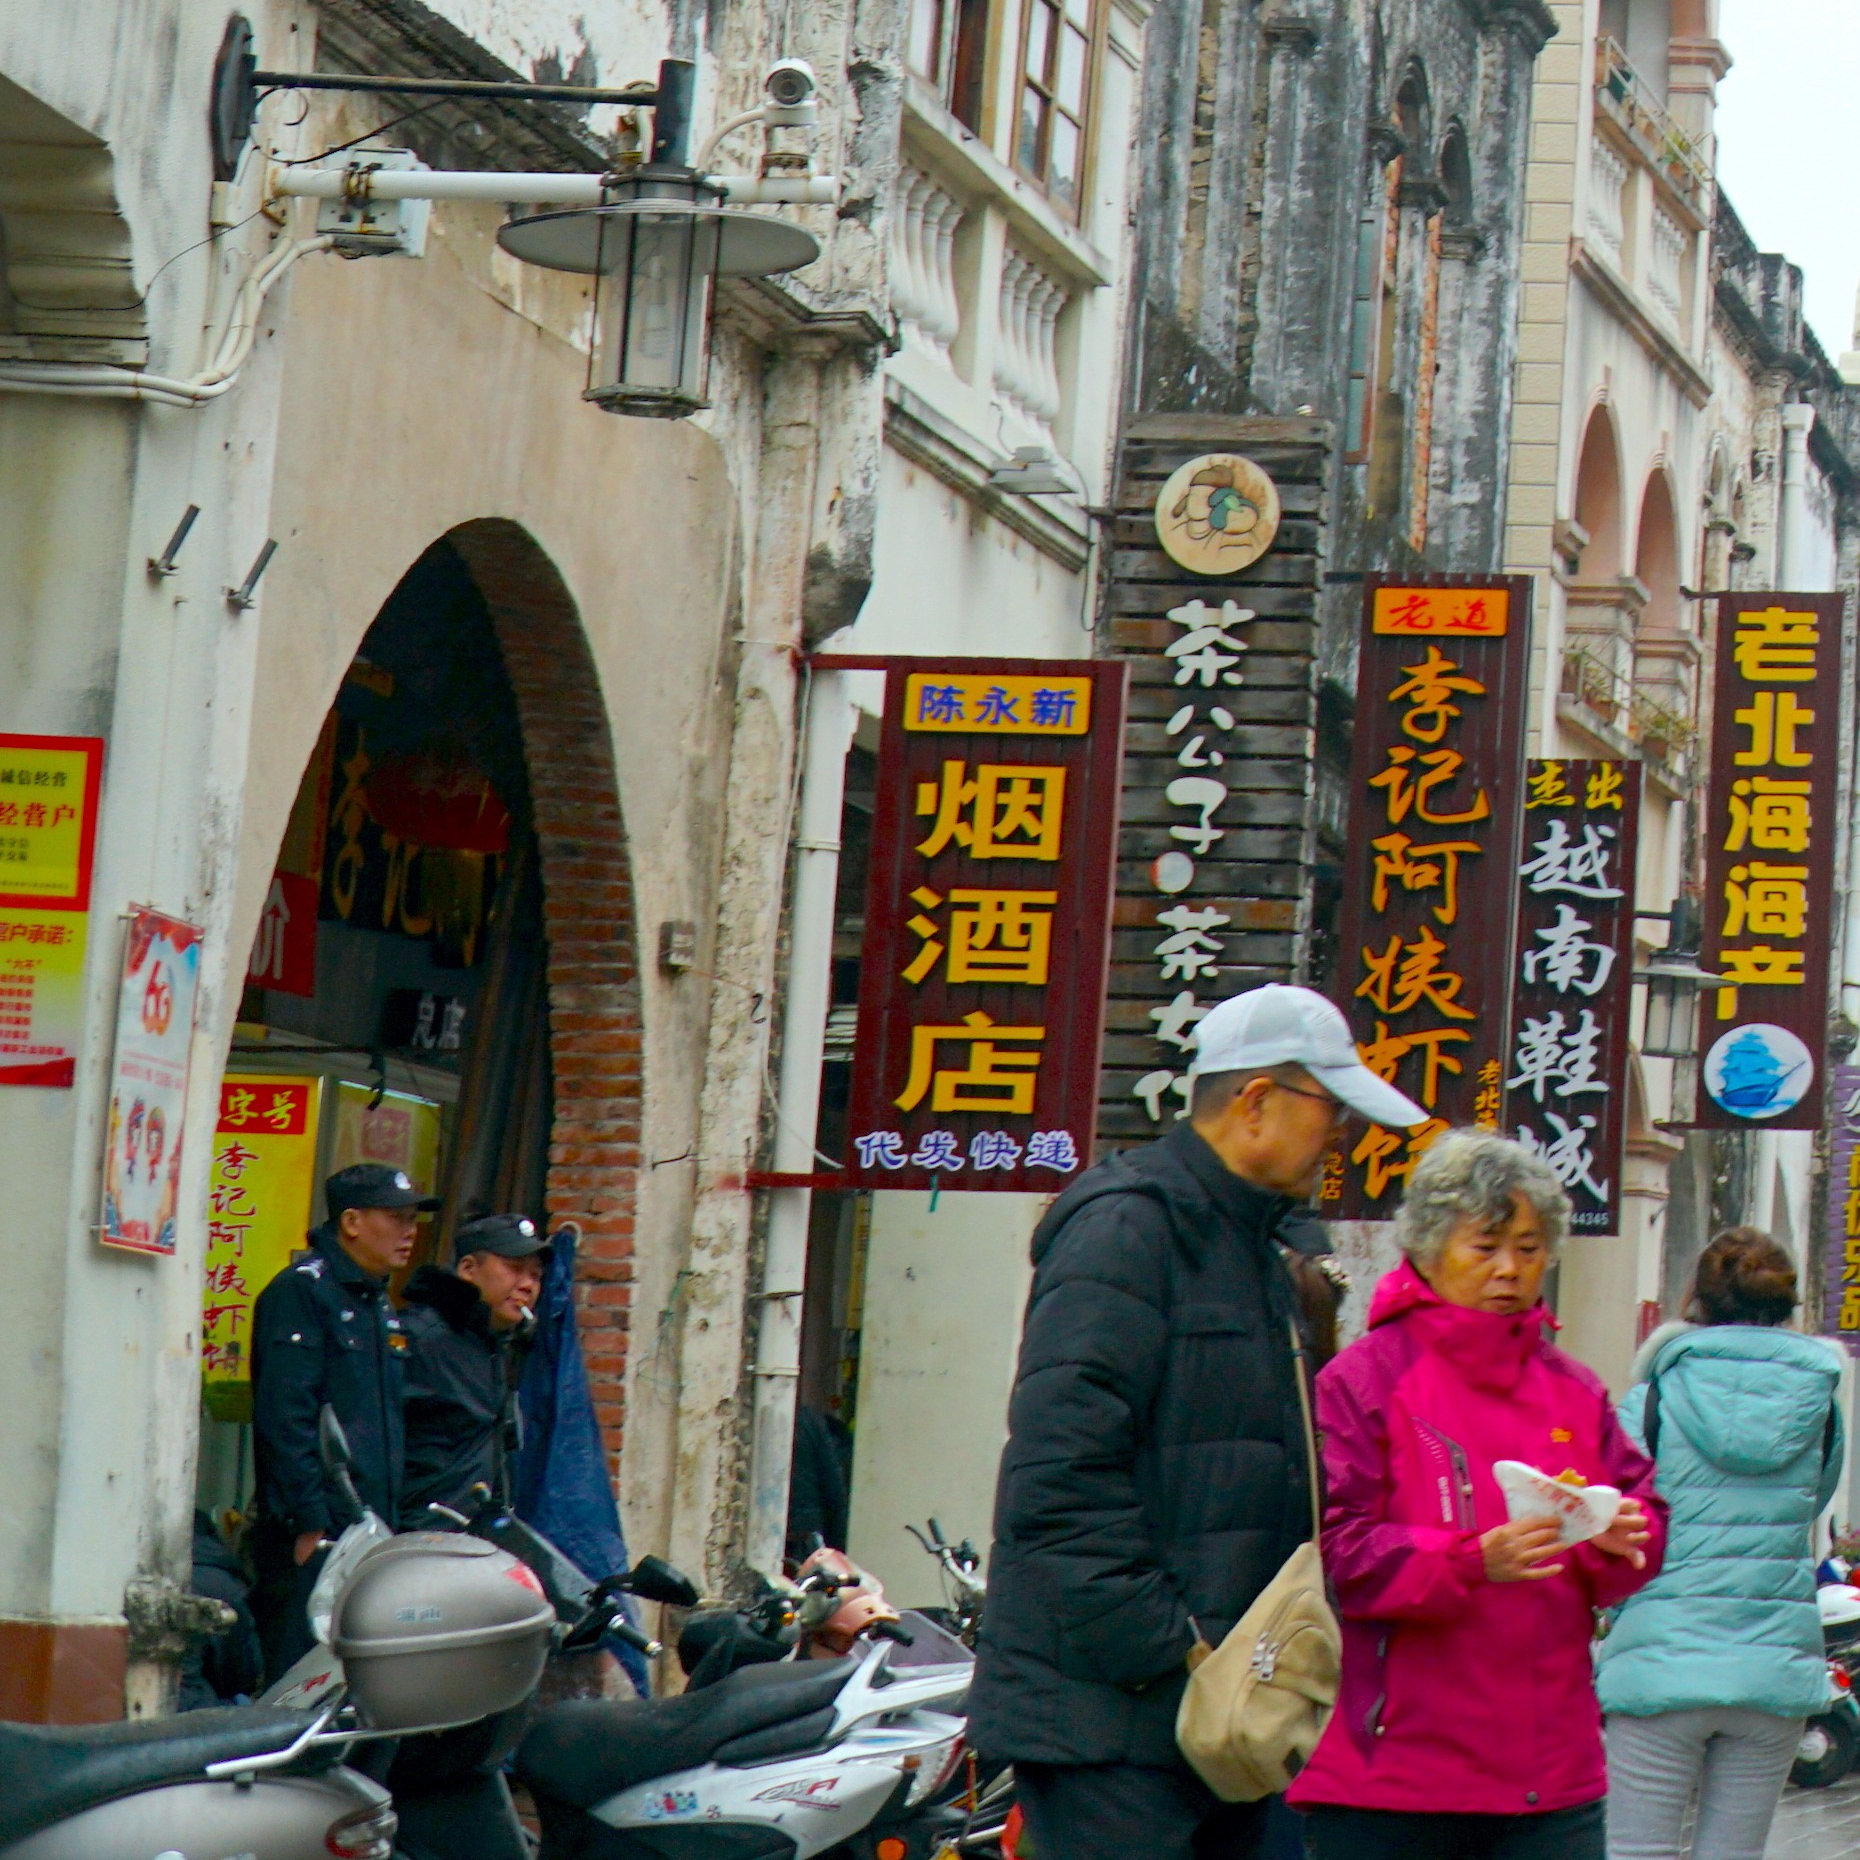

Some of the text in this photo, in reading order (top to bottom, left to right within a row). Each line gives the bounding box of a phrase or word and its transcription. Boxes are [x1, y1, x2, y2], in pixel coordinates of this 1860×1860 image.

[1388, 593, 1496, 632] 老道
[916, 685, 1079, 727] 陈永新
[1165, 600, 1255, 856] 茶公子
[1526, 761, 1625, 808] 杰出
[1717, 605, 1820, 1020] 老北海海产
[893, 759, 1066, 1115] 烟酒店
[1506, 819, 1625, 1202] 越南鞋城
[223, 1088, 297, 1130] 字号
[856, 1132, 1079, 1172] 代发快递
